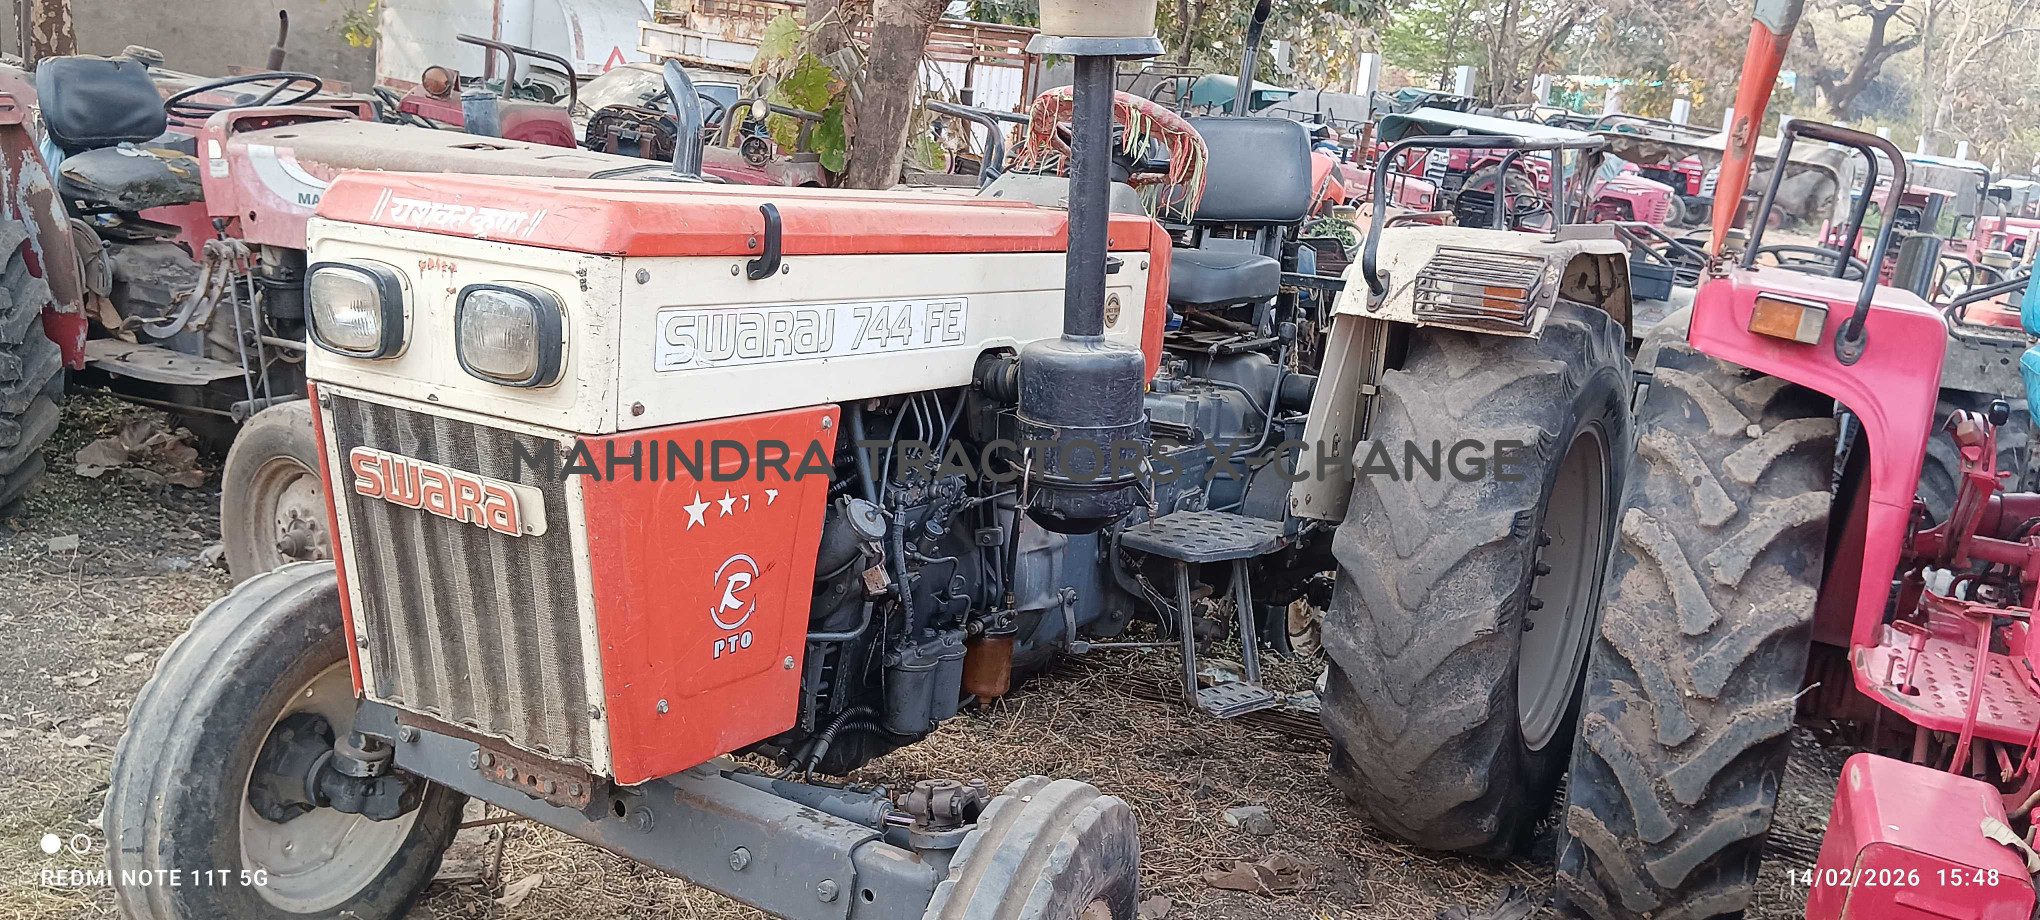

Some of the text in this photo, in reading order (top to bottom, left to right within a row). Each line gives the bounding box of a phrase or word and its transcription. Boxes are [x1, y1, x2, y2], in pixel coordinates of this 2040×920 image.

[850, 304, 913, 350] 744
[923, 302, 962, 344] FE
[712, 629, 753, 660] PTO
